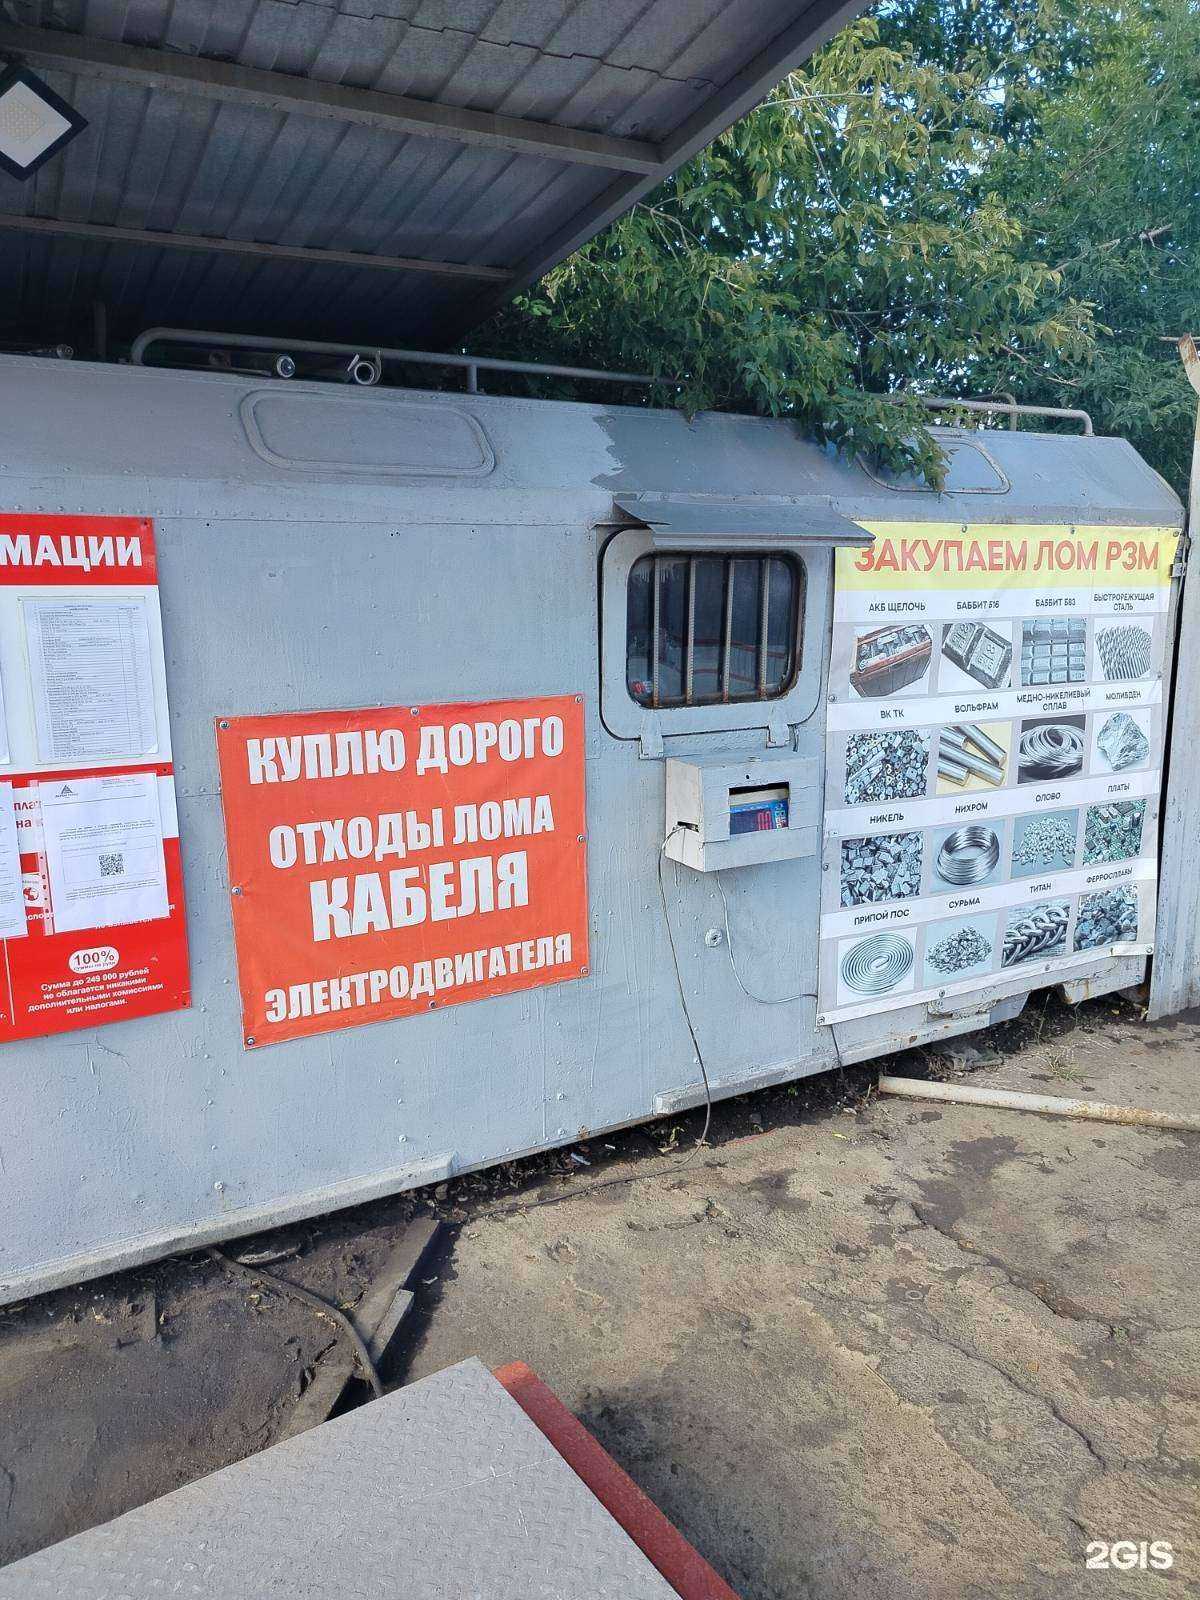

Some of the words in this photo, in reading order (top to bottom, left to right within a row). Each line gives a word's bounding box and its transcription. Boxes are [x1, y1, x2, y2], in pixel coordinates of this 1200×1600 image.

[0, 534, 143, 572] МАЦИИ
[854, 539, 1028, 572] ЗАКУПАЕМ
[1033, 541, 1099, 571] ЛОМ
[1105, 541, 1159, 571] РЗМ
[1035, 598, 1063, 607] БАББИТ
[1093, 592, 1155, 602] БЫСТРОРЕЖУЩАЯ
[868, 603, 886, 612] АКБ
[887, 602, 926, 613] ЩЕЛОЧЬ
[956, 601, 987, 610] БАББИТ
[1113, 603, 1134, 611] СТАЛЬ
[1105, 690, 1142, 700] МОЛИБДЕН
[954, 702, 999, 713] ВОЛЬФРАМ
[1042, 702, 1067, 711] СПЛАВ
[880, 710, 891, 718] ВК
[893, 709, 904, 718] ТК
[246, 729, 406, 785] КУПЛЮ
[416, 716, 565, 776] ДОРОГО
[1107, 783, 1130, 793] ПЛАТЫ
[1035, 792, 1061, 802] ОЛОВО
[13, 800, 40, 811] пла
[954, 802, 988, 814] НИХРОМ
[869, 812, 905, 824] НИКЕЛЬ
[268, 808, 443, 869] ОТХОДЫ
[452, 794, 555, 846] ЛОМА
[1029, 883, 1052, 893] ТИТАН
[308, 850, 529, 942] КАБЕЛЯ
[948, 897, 981, 909] СУРЬМА
[854, 911, 889, 925] ПРИПОЙ
[890, 909, 910, 920] ПОС
[74, 950, 115, 965] 100%
[265, 932, 572, 1023] ЭЛЕКТРОДВИГАТЕЛЯ
[41, 981, 71, 991] Сумма
[72, 979, 85, 988] до
